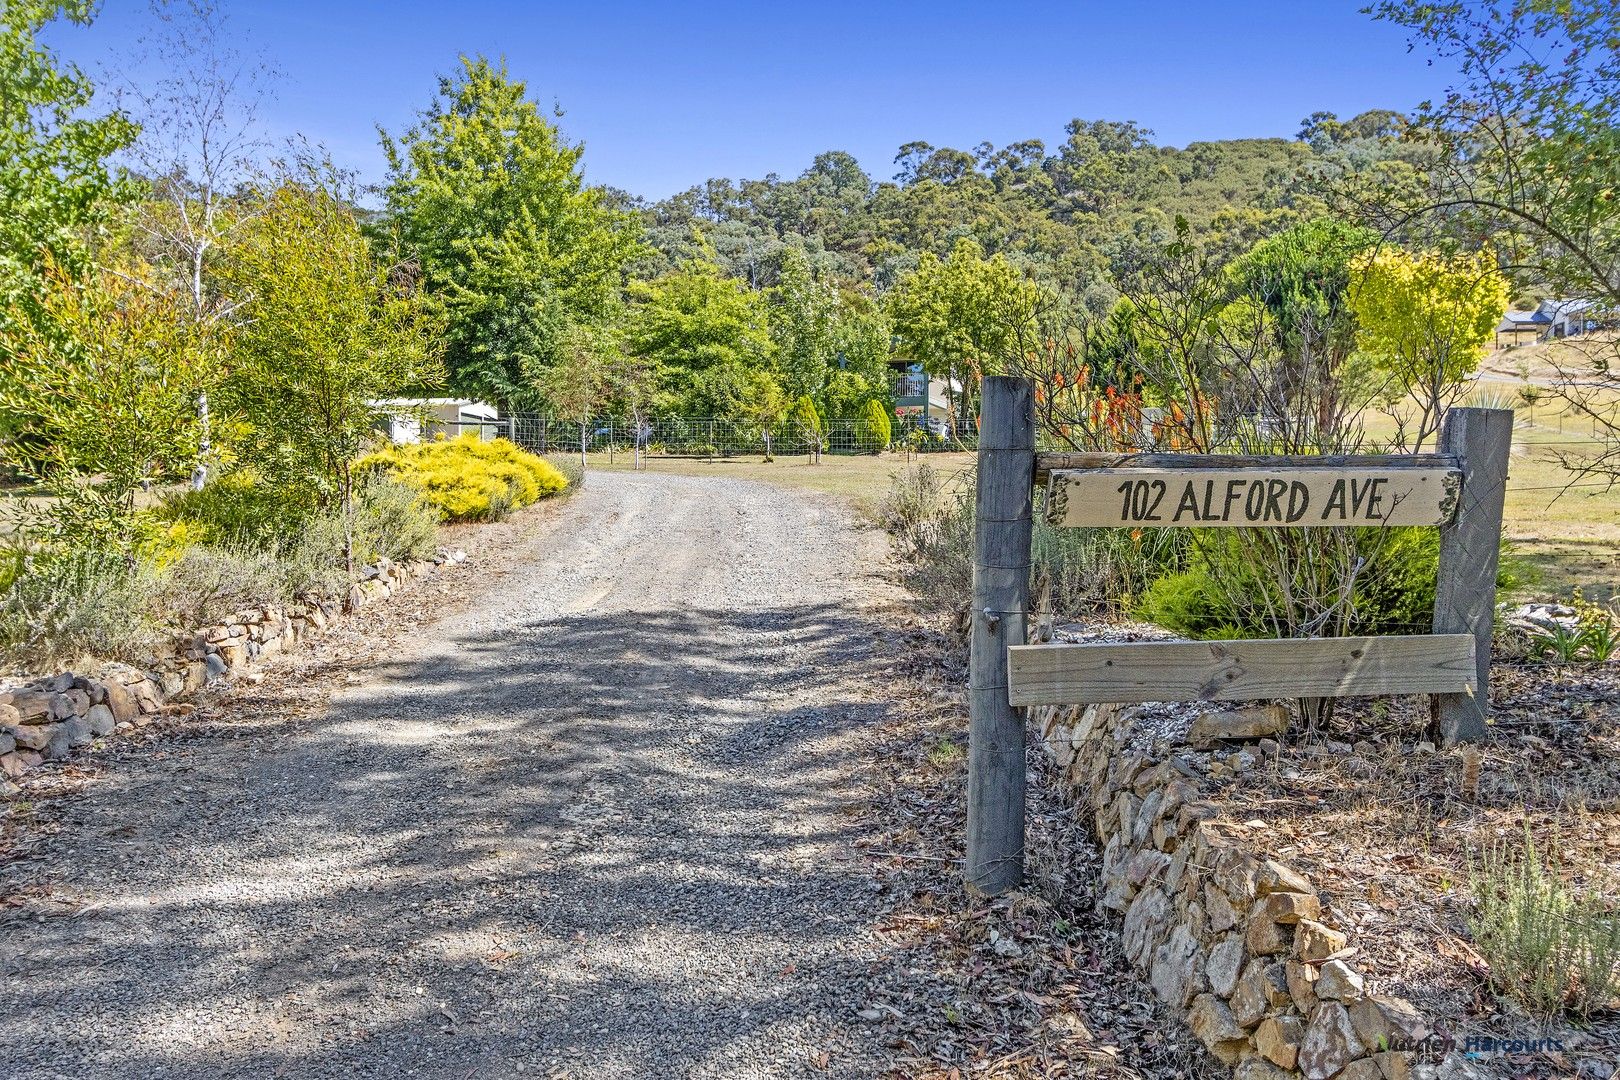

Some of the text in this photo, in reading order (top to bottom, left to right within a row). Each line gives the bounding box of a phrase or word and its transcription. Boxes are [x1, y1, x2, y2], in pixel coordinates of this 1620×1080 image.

[1117, 478, 1388, 522] 102 ALFORD AVE
